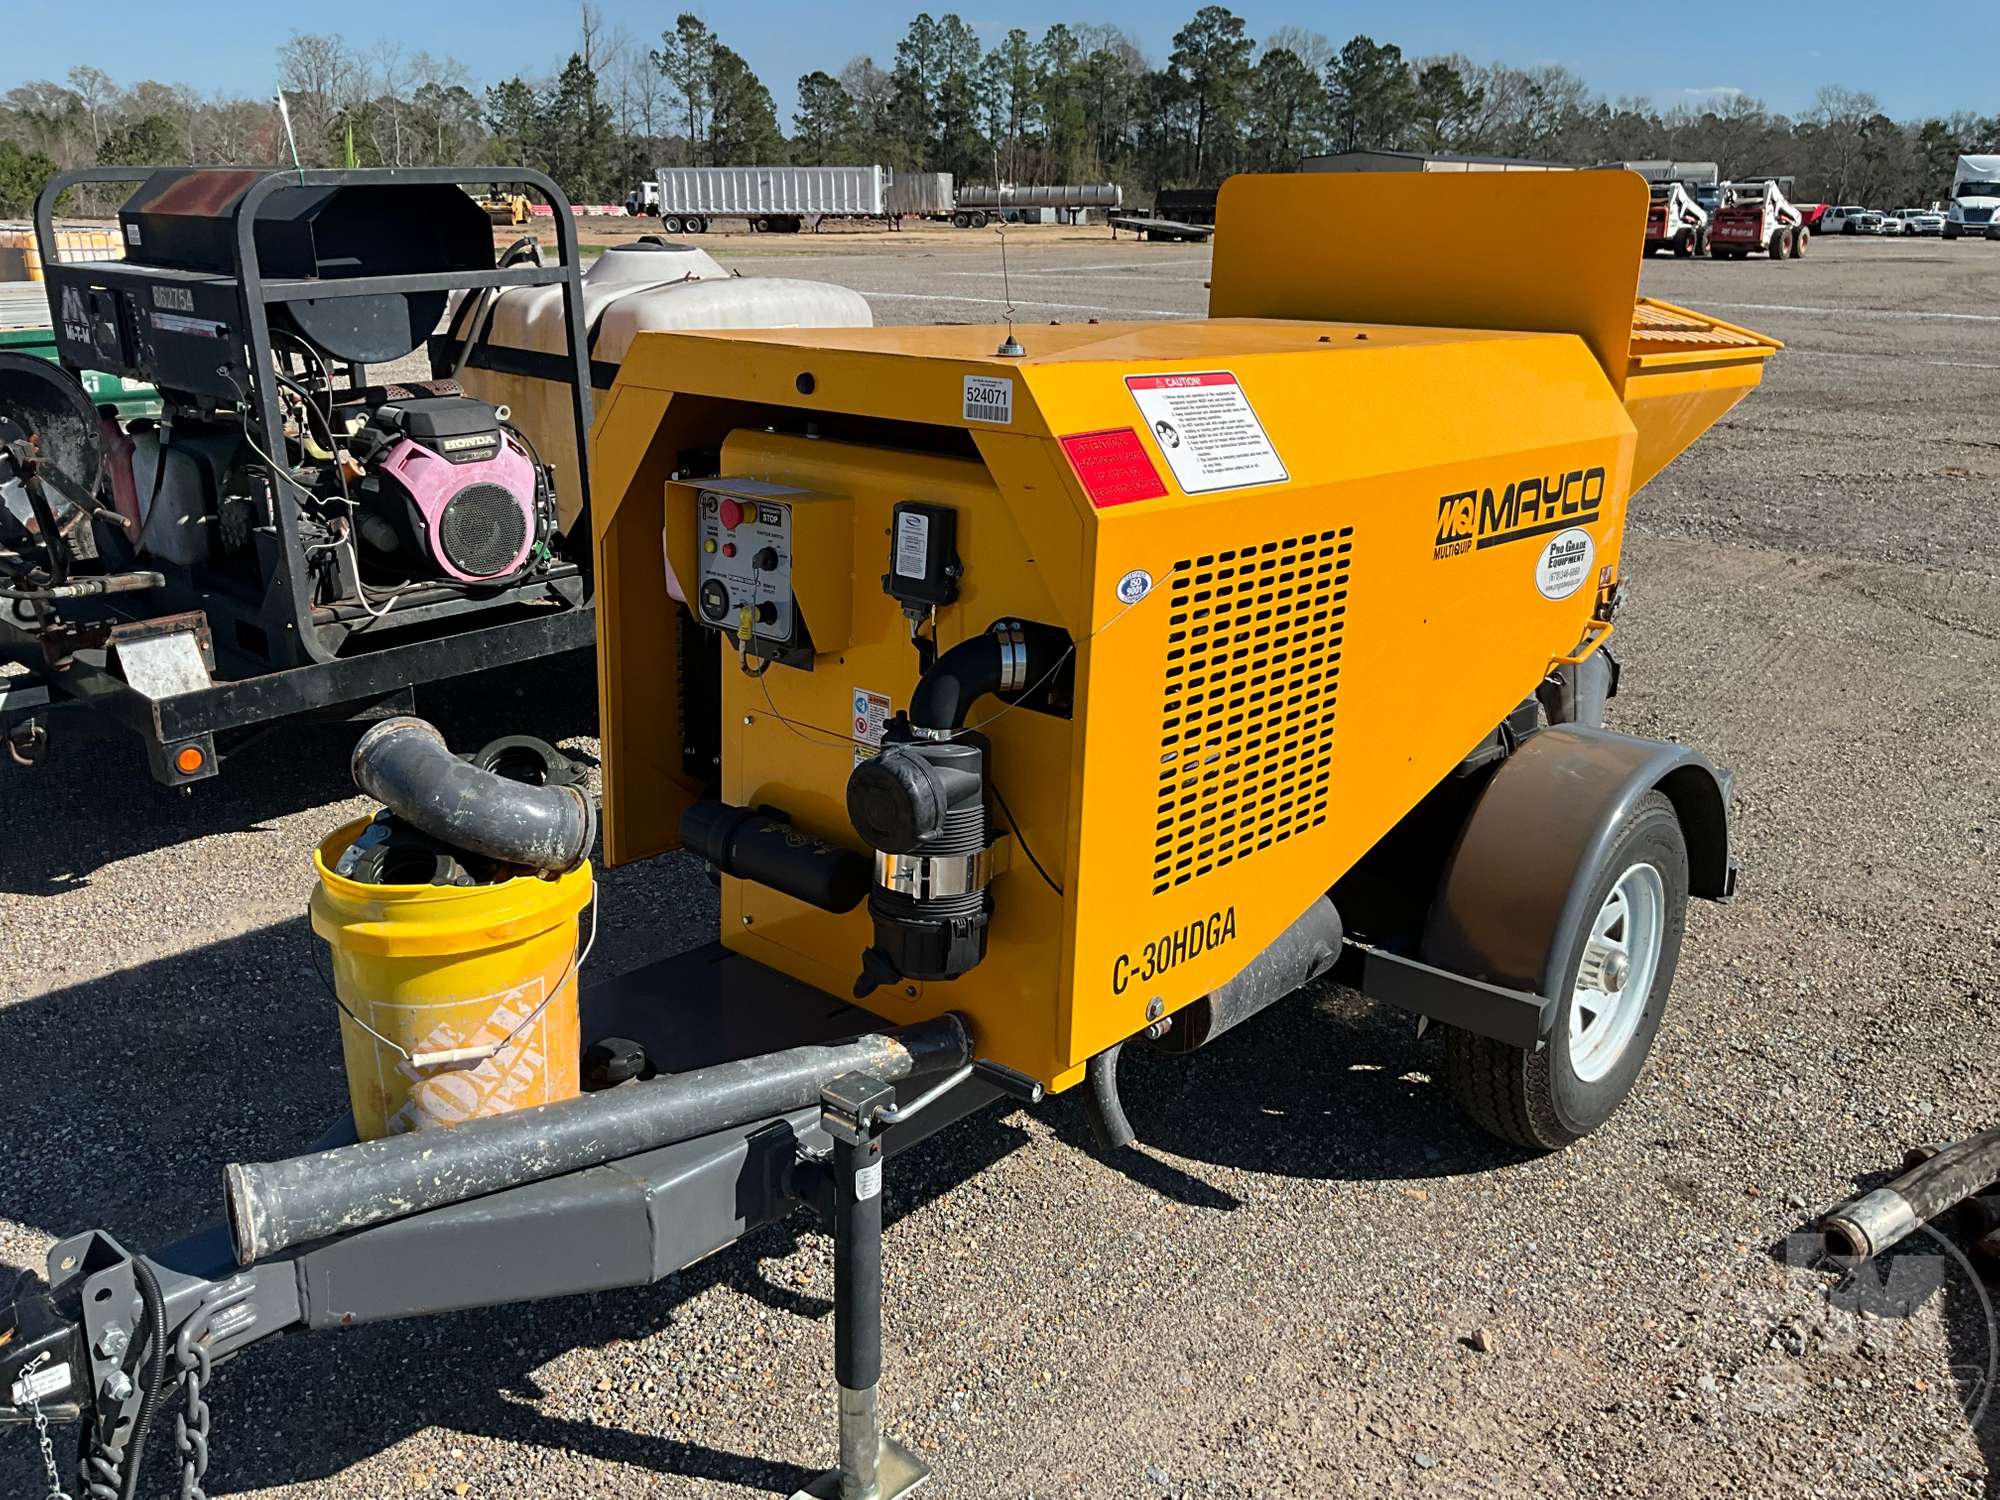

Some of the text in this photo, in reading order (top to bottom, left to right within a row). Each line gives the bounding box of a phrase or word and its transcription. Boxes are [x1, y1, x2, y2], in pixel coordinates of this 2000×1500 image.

[967, 387, 1007, 405] 524071
[444, 435, 497, 450] HONDA
[1478, 467, 1605, 535] MAYCO
[762, 514, 778, 523] STOP
[1433, 540, 1472, 561] MULTIQUIP
[1113, 906, 1236, 995] C-30HDGA
